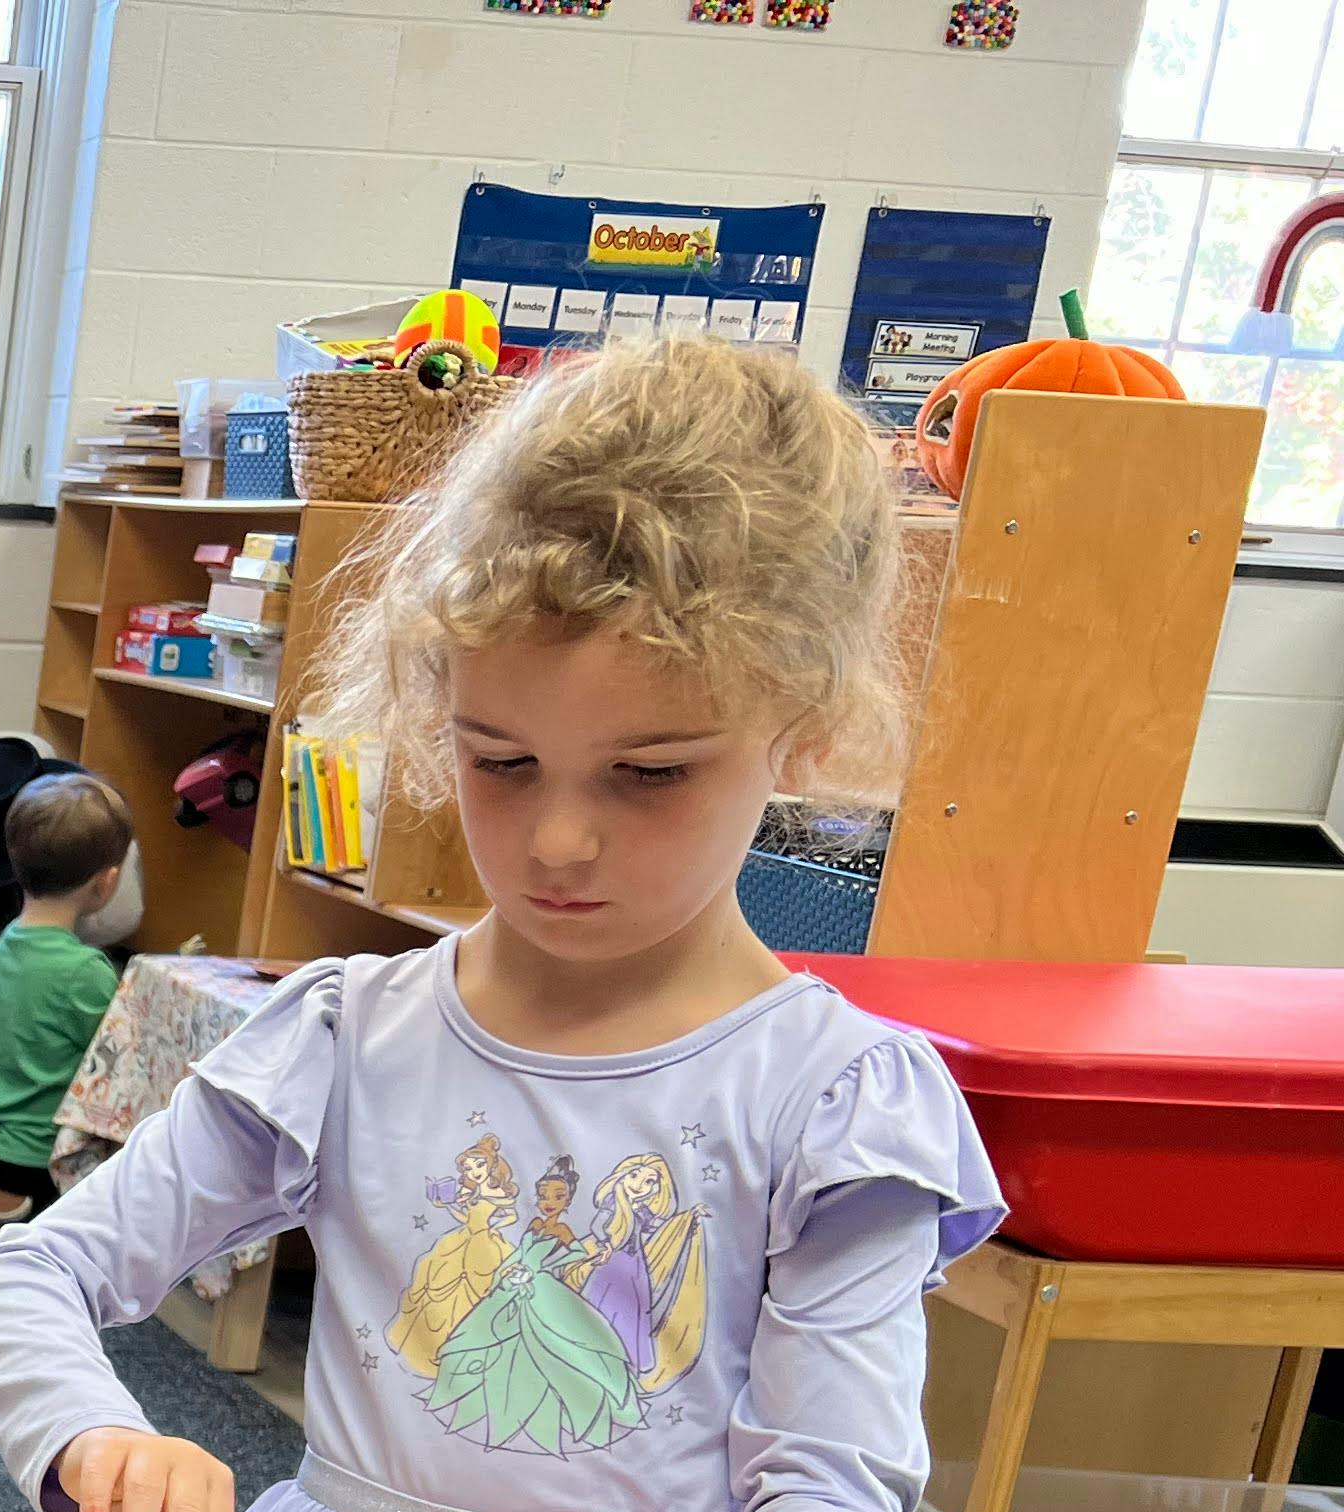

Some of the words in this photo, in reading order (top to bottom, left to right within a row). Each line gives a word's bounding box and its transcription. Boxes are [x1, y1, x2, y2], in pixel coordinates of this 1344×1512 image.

[594, 224, 690, 252] October
[513, 301, 547, 313] Monday
[564, 305, 597, 316] Tuesday
[614, 310, 653, 320] Wednesday
[719, 315, 742, 326] Friday
[924, 331, 959, 343] Morning
[922, 343, 956, 354] Meeting
[906, 372, 946, 382] Playgrou
